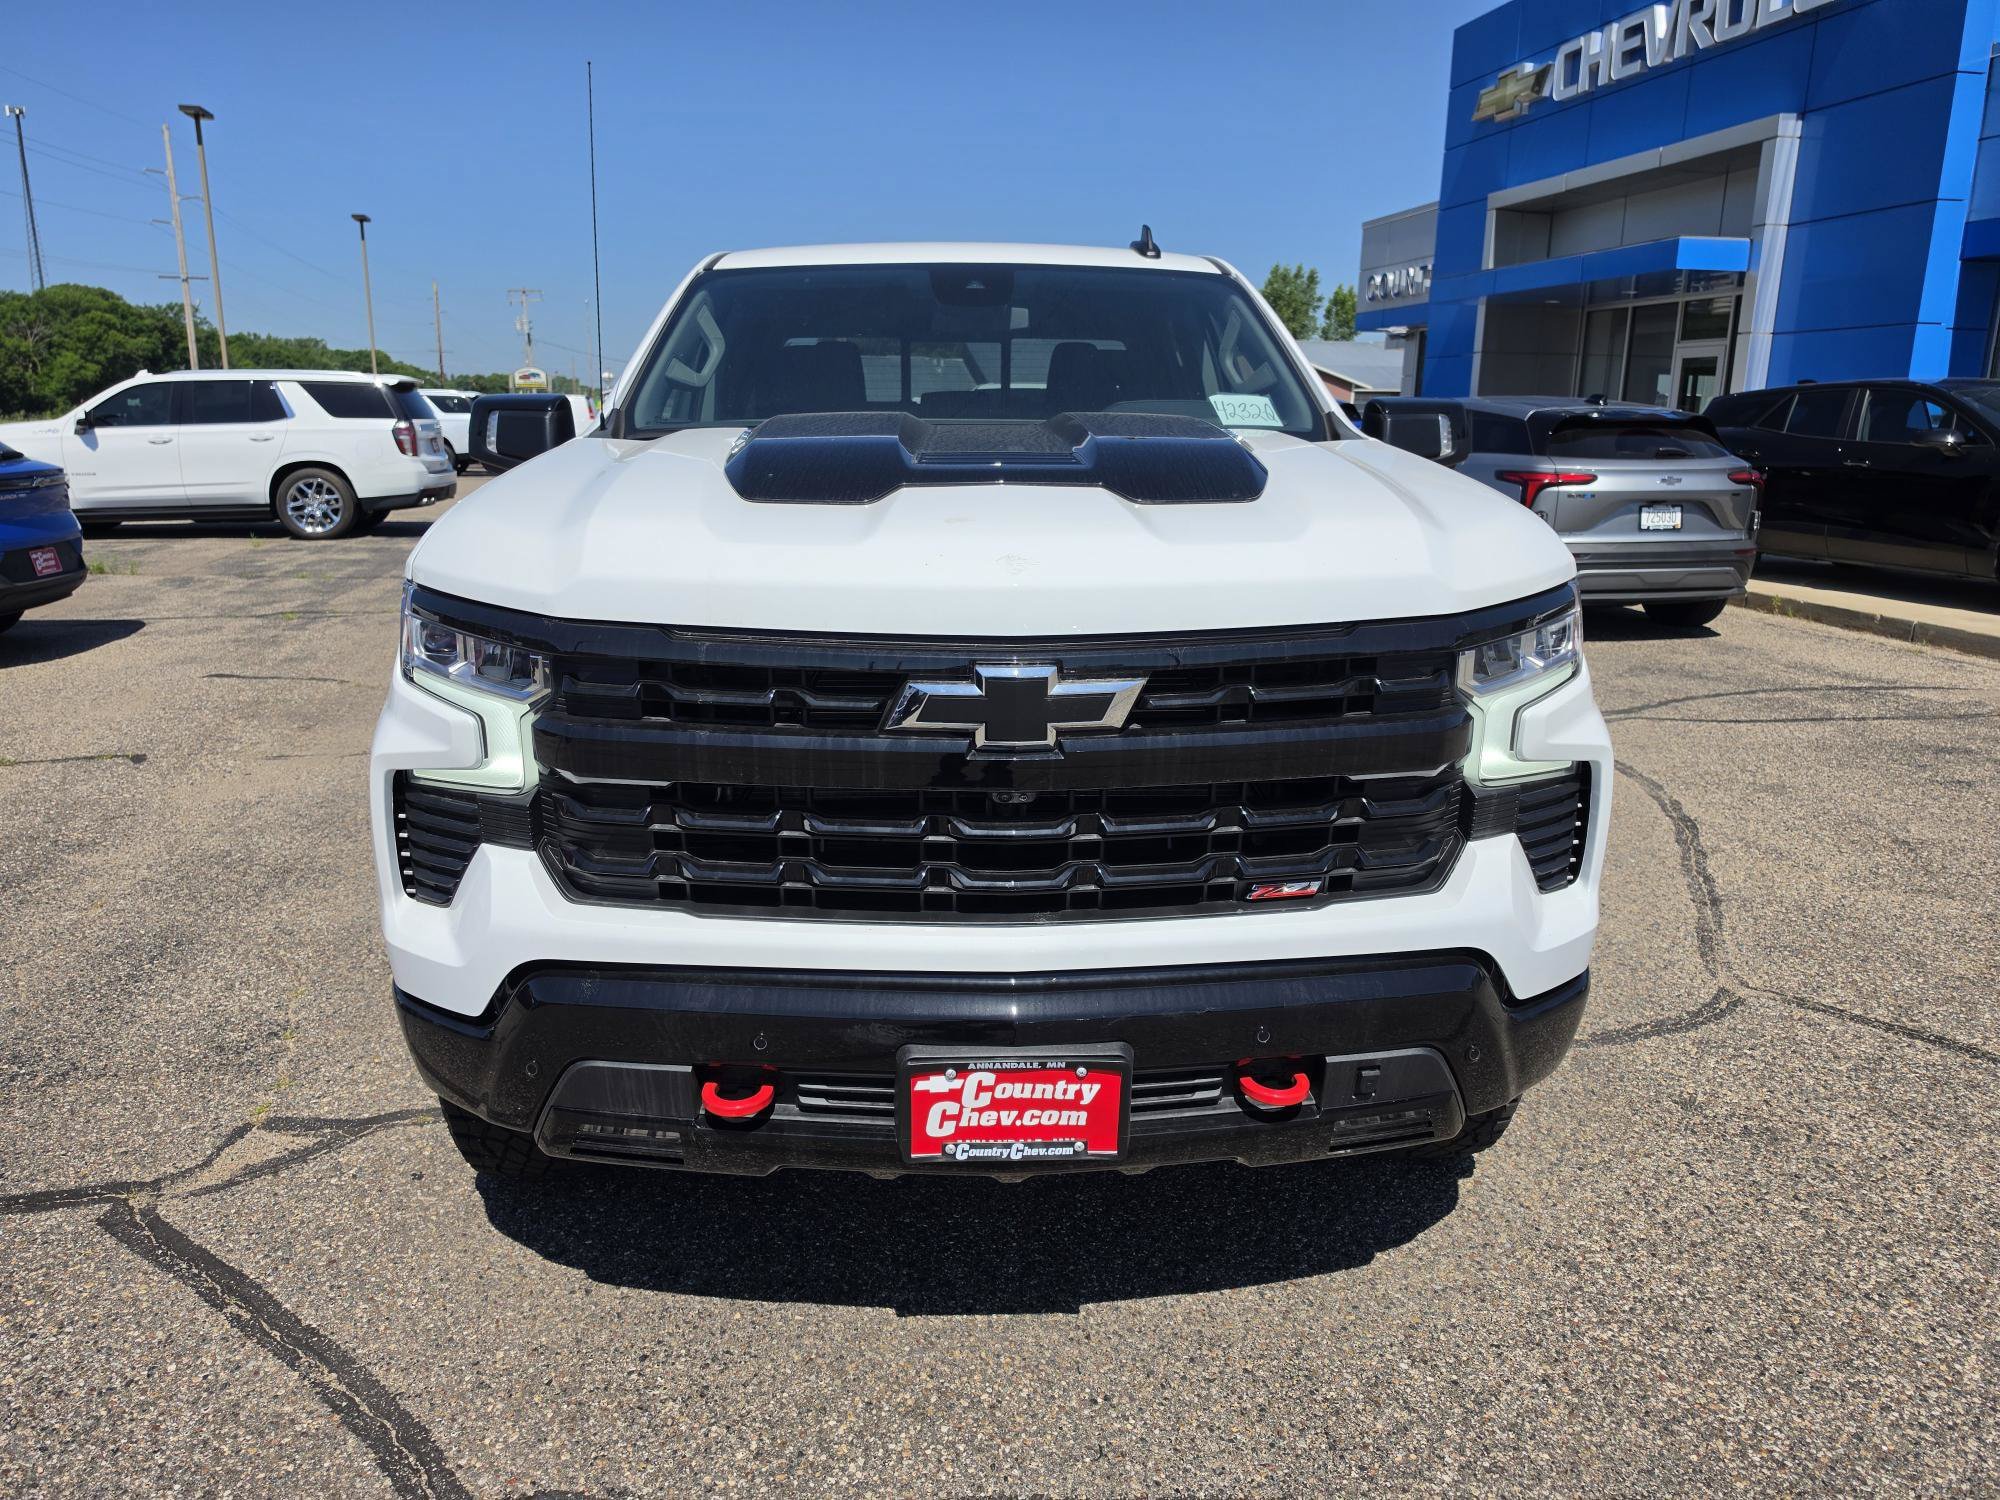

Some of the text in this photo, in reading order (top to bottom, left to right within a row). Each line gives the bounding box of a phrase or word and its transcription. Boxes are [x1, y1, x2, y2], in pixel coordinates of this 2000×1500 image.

[1553, 0, 1834, 101] CHEVROL
[1046, 1061, 1066, 1069] MN
[961, 1071, 1101, 1109] Country
[925, 1101, 1088, 1138] Chev.com
[955, 1143, 1074, 1161] CountryChev.com
